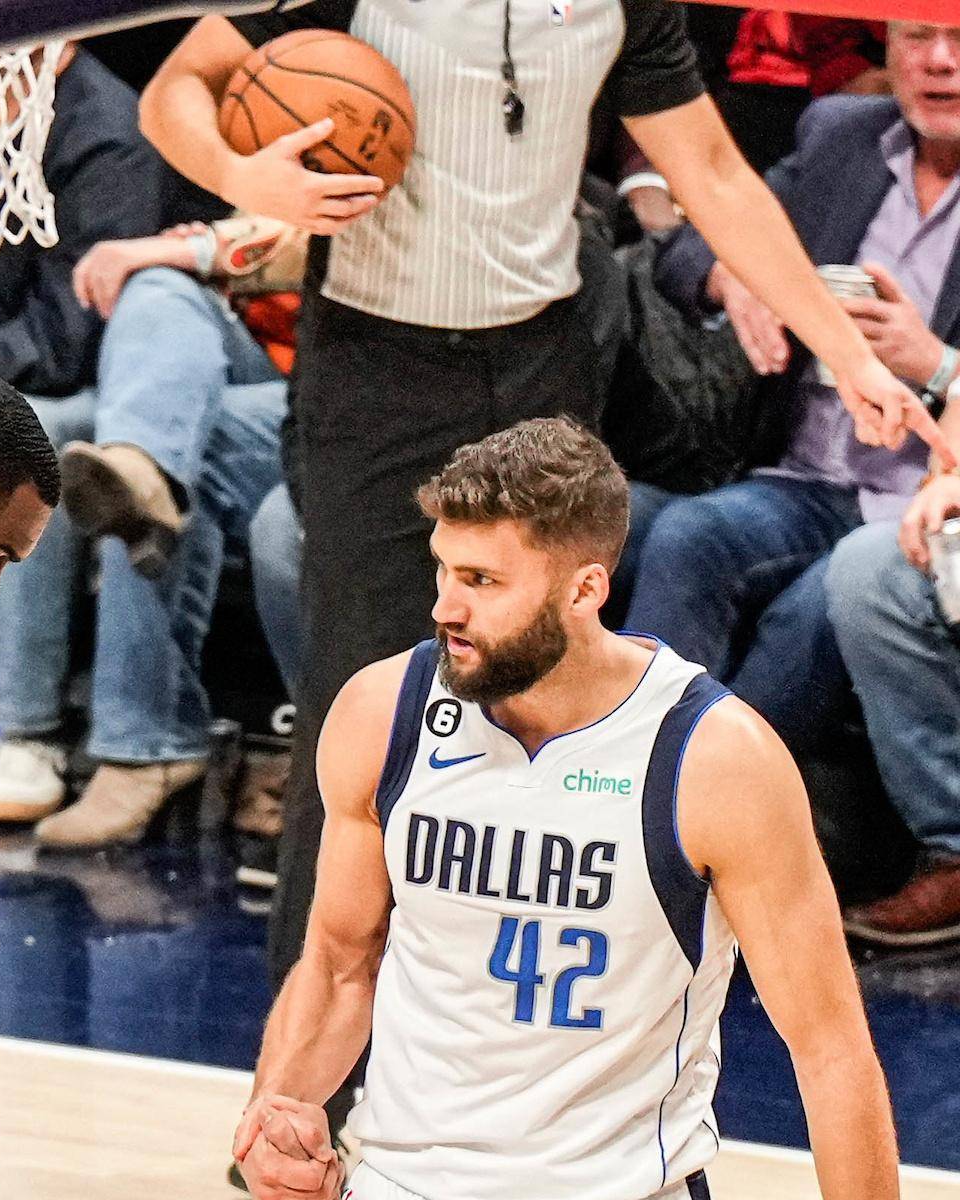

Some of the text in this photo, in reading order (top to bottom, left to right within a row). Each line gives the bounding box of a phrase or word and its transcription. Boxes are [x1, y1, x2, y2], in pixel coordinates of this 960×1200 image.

[430, 700, 460, 736] 6
[563, 768, 632, 795] chime
[405, 811, 619, 913] DALLAS
[487, 913, 611, 1032] 42
